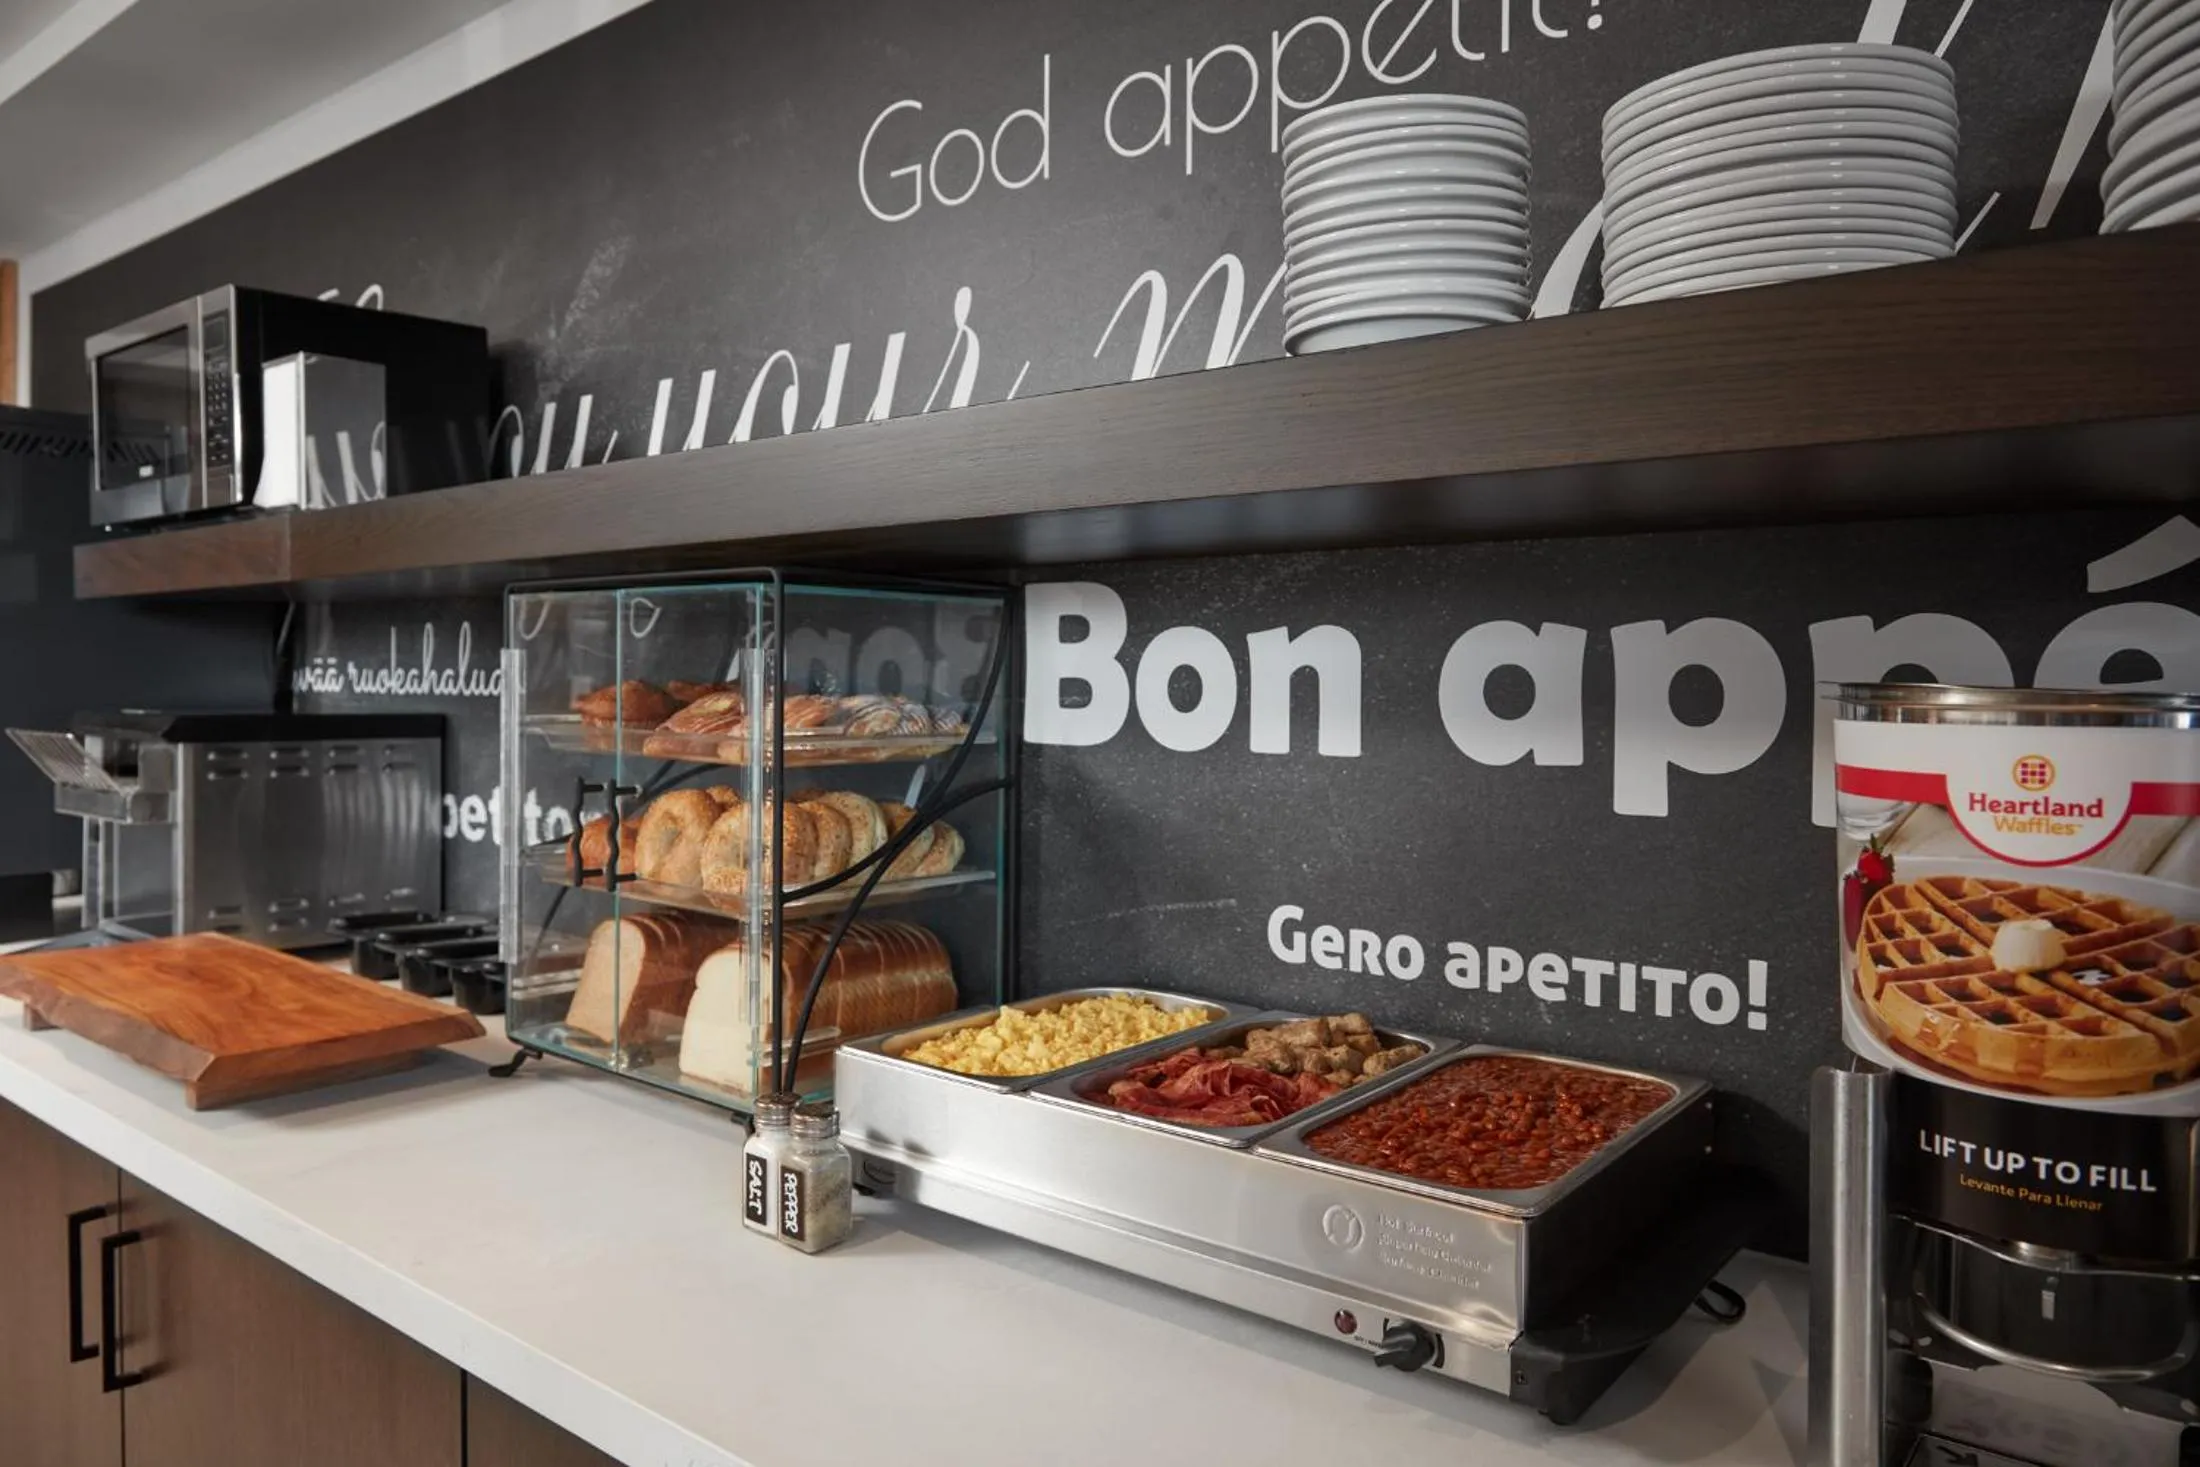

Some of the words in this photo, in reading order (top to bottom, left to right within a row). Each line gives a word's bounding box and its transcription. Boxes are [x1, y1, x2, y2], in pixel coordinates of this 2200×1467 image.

[858, 53, 1050, 222] God
[1104, 0, 1603, 174] appe
[1022, 581, 1363, 756] Bon
[1968, 792, 2104, 818] Heartland
[748, 1160, 763, 1216] SALT
[1920, 1129, 1976, 1164] LIFT
[1984, 1147, 2026, 1174] UP
[2032, 1156, 2081, 1185] TO
[2090, 1165, 2157, 1192] FILL
[784, 1173, 799, 1234] PEPPER
[1959, 1173, 2015, 1197] Levante
[2019, 1187, 2052, 1206] Para
[2056, 1194, 2104, 1212] Llenar
